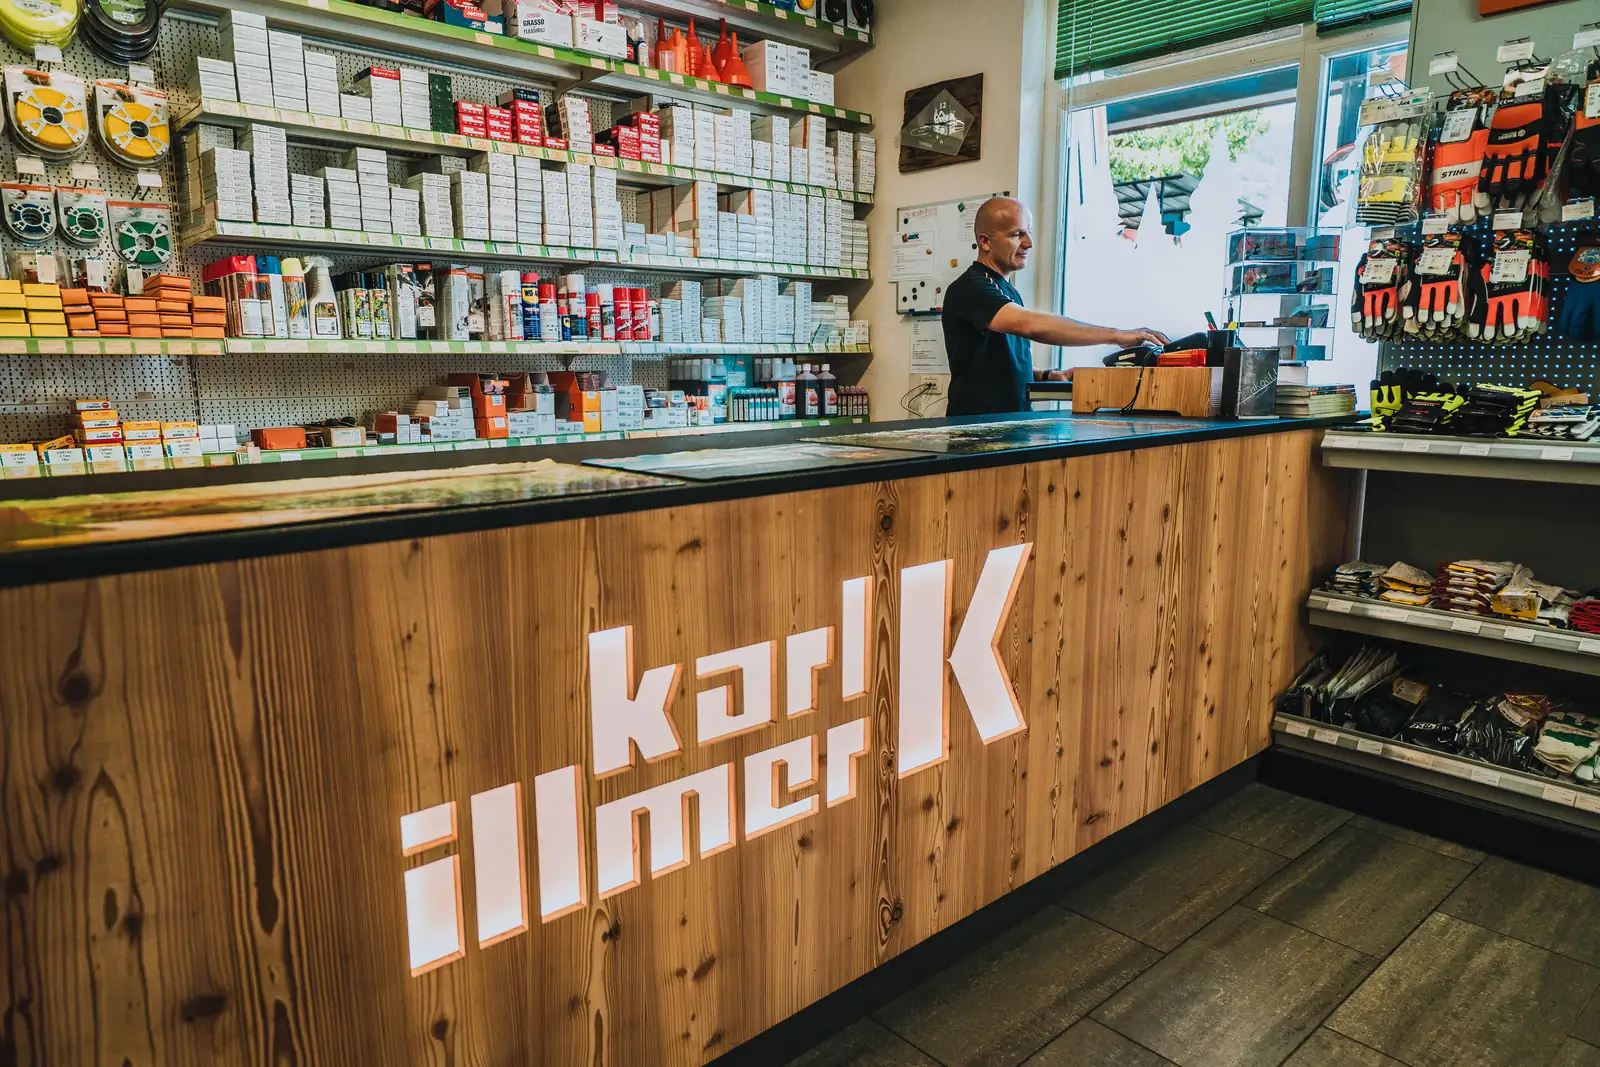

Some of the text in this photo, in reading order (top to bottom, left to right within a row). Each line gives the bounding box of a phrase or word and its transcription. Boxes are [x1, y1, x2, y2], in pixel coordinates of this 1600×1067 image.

[522, 18, 545, 27] GRASSO
[939, 101, 947, 109] 12
[1440, 167, 1469, 179] STIHL
[588, 575, 873, 781] karl
[897, 542, 1034, 780] K
[399, 716, 872, 978] illmer
